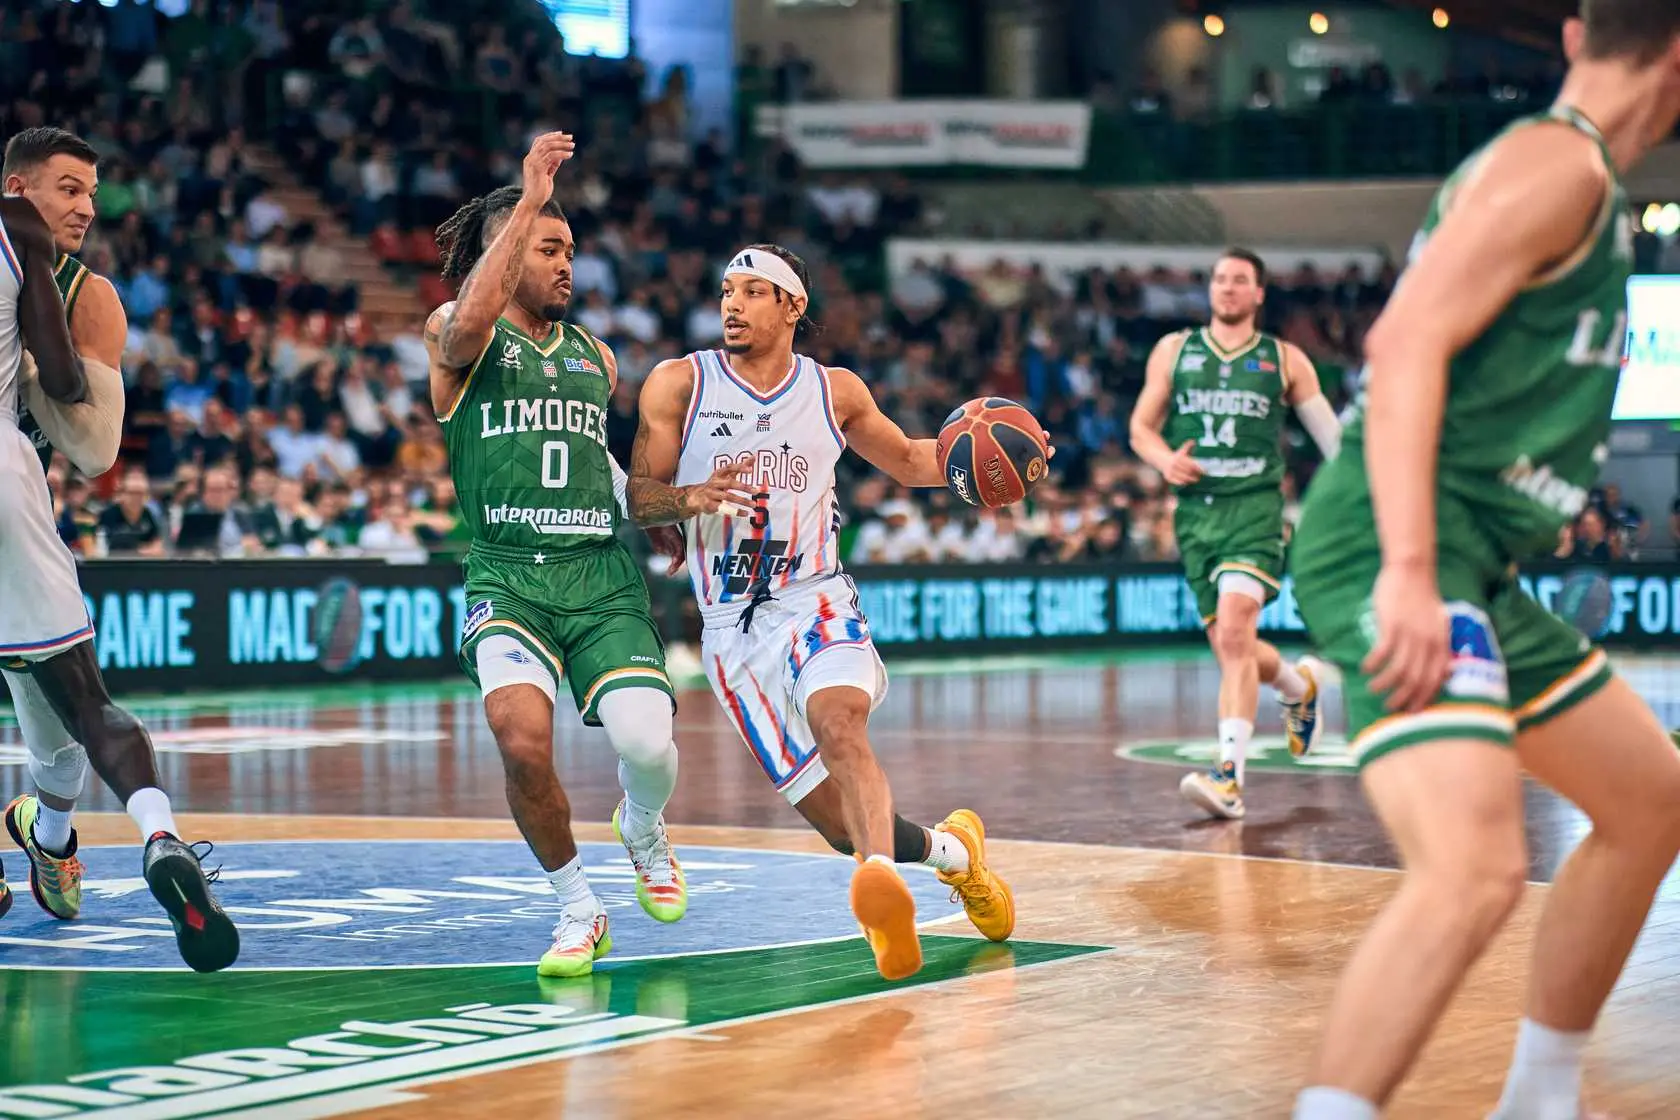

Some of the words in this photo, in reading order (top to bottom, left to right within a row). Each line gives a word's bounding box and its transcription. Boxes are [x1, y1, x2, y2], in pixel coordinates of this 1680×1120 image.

[480, 398, 608, 447] LIMOGES
[1198, 413, 1238, 448] 14
[541, 440, 569, 488] 0
[750, 493, 770, 529] 5
[86, 591, 195, 668] AME
[358, 589, 442, 659] FOR
